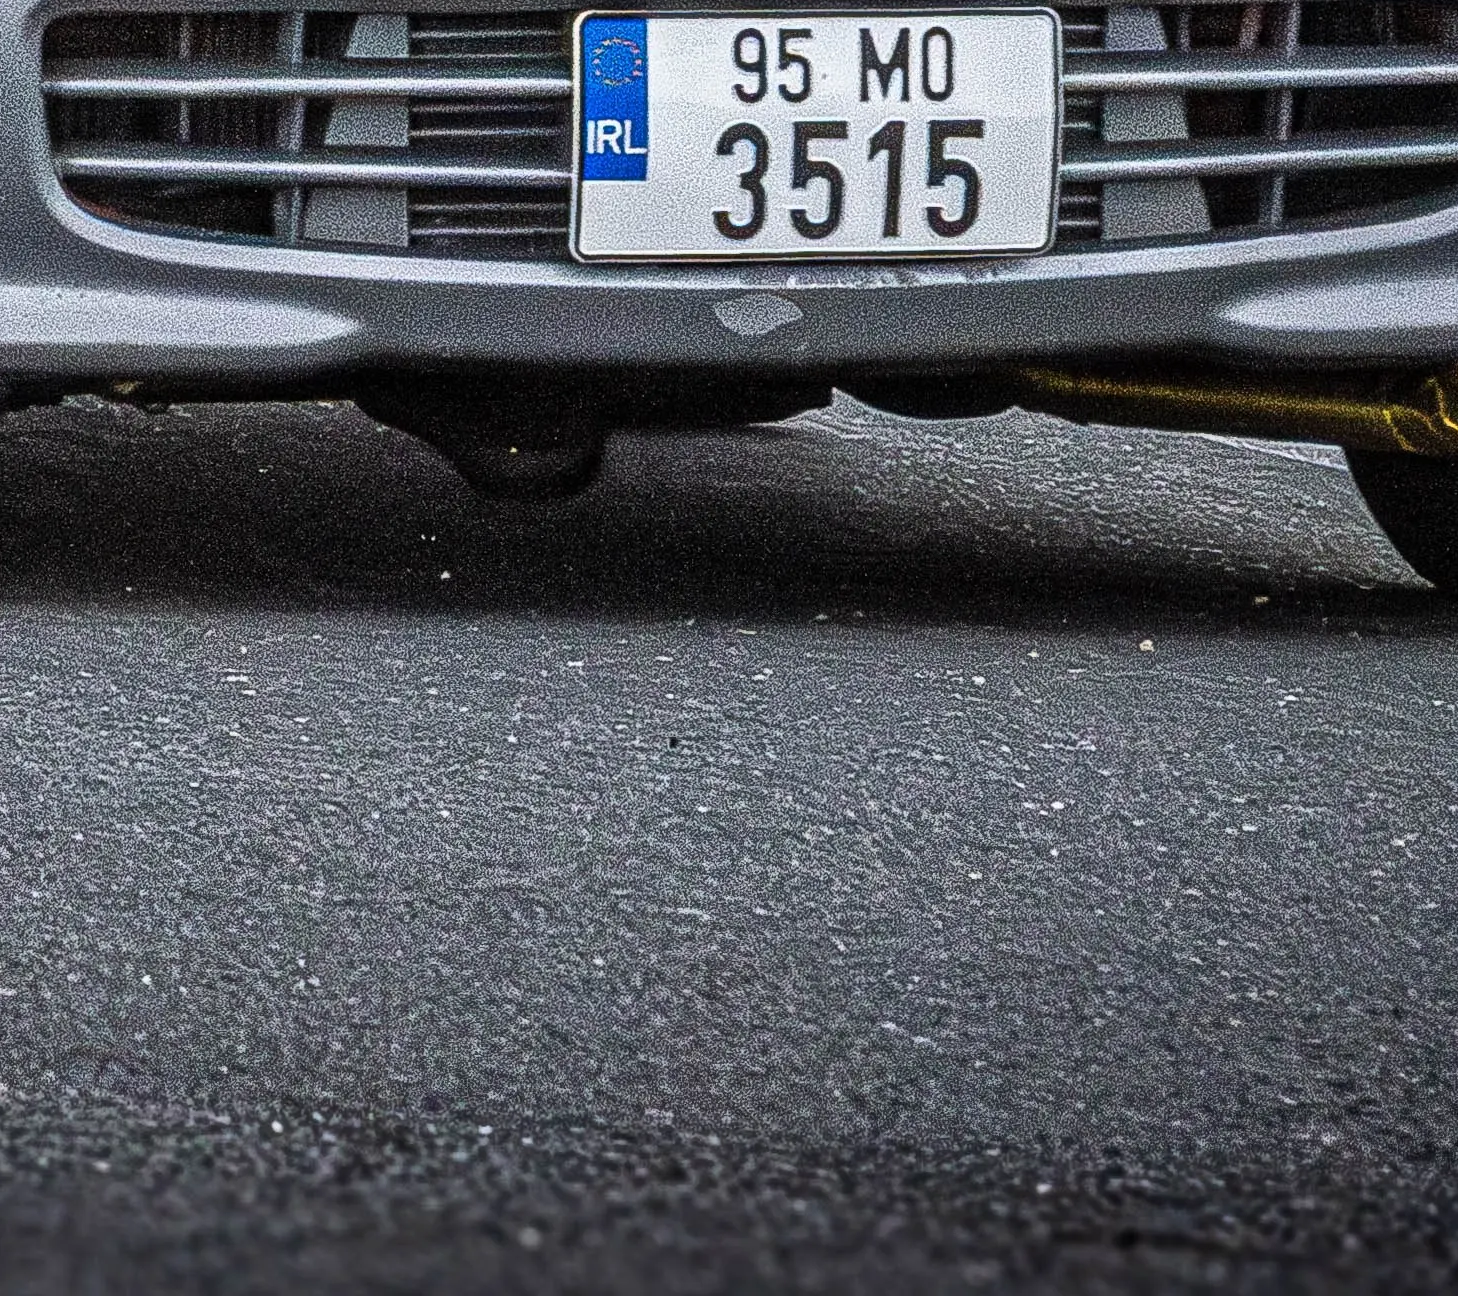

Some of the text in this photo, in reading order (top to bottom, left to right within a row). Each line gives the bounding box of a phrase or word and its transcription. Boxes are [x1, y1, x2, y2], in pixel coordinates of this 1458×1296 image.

[732, 25, 955, 105] 95 MO
[586, 119, 648, 155] IRL
[712, 119, 986, 242] 3515
